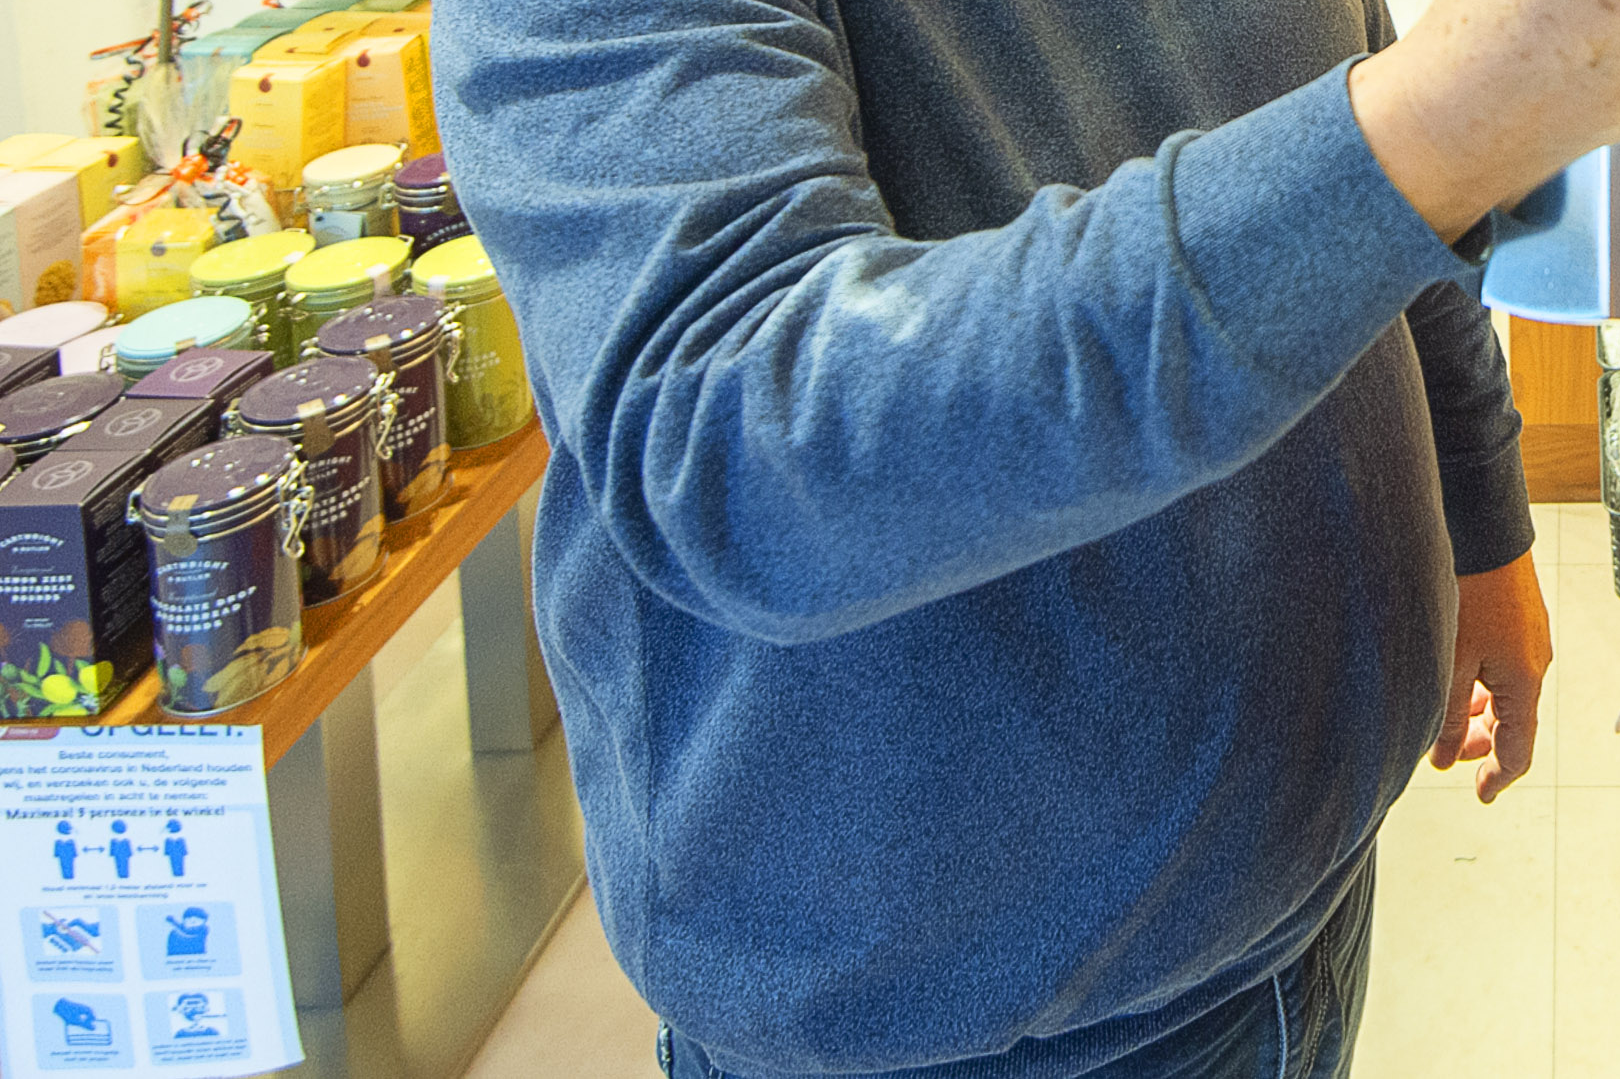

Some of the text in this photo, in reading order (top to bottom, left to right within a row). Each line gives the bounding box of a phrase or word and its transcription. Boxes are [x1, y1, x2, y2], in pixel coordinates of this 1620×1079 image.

[0, 583, 76, 595] HORTBREAD
[215, 585, 258, 609] DROP
[58, 750, 94, 760] Beste
[141, 763, 203, 772] Nederland
[207, 762, 253, 772] houden
